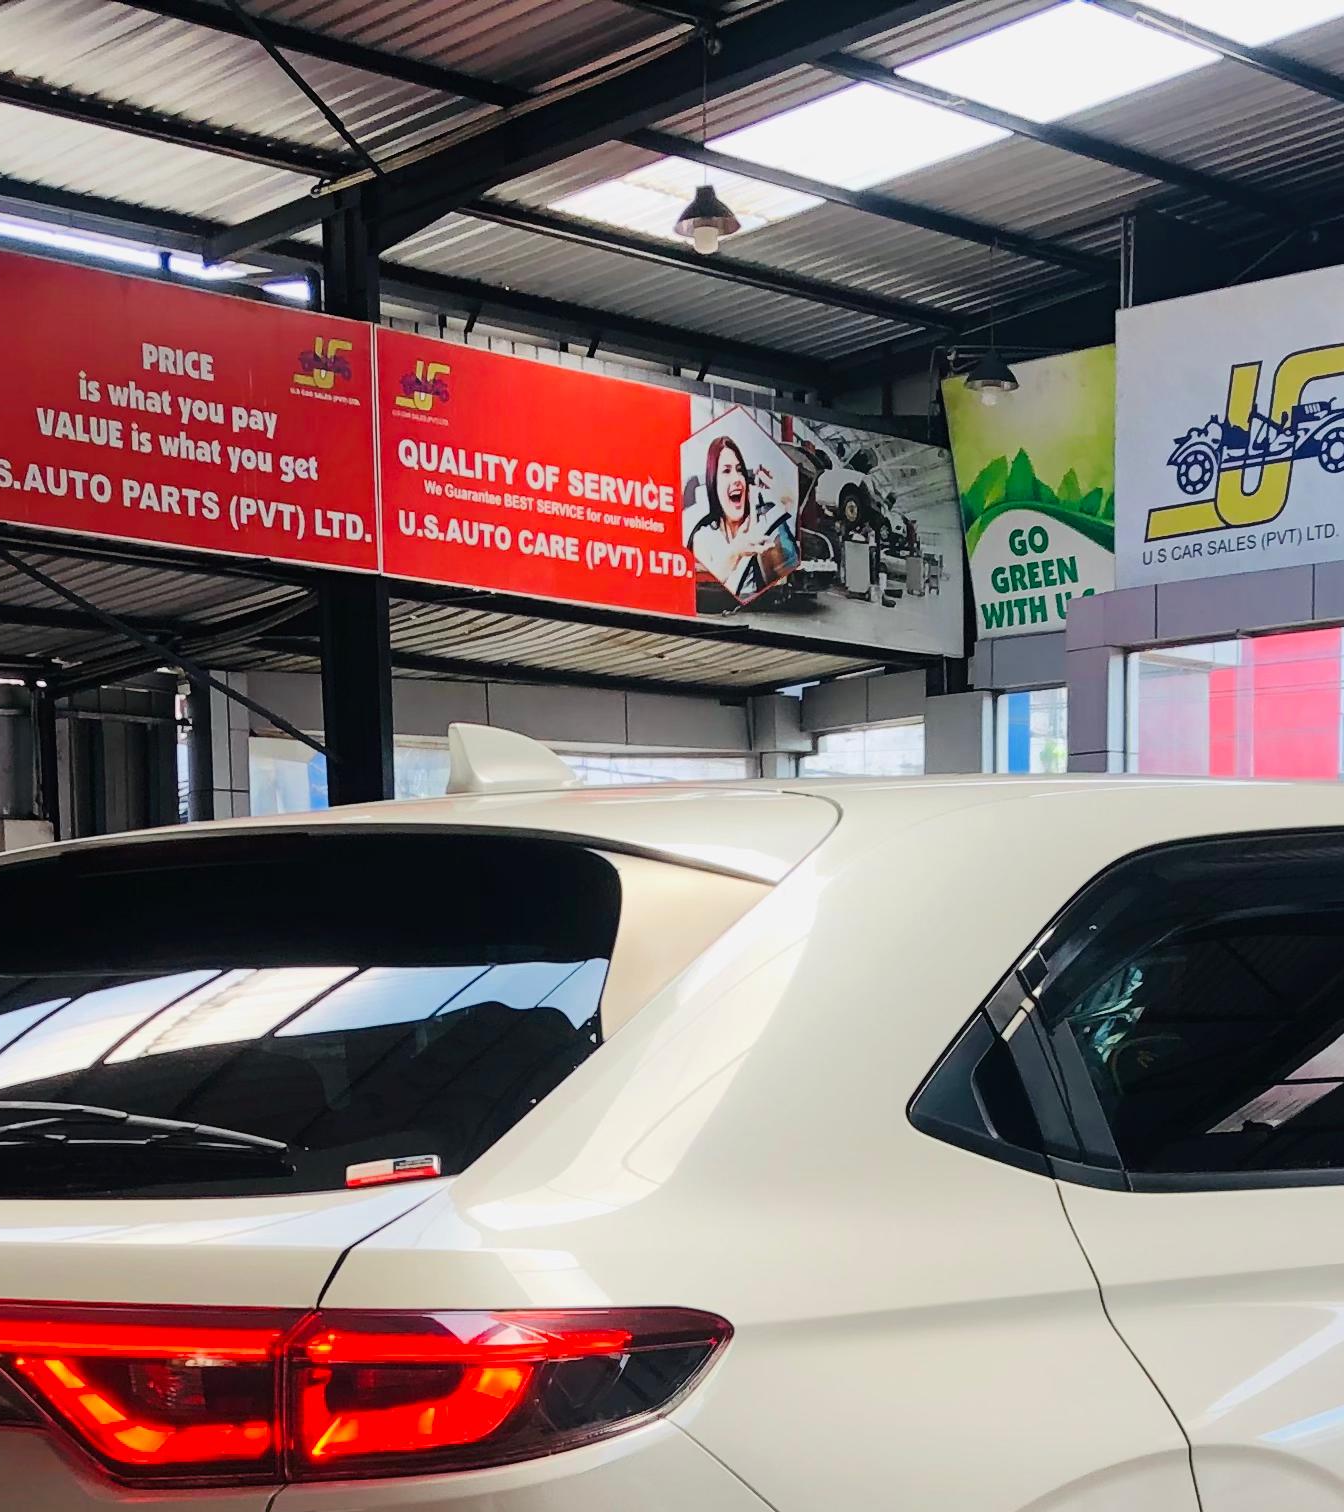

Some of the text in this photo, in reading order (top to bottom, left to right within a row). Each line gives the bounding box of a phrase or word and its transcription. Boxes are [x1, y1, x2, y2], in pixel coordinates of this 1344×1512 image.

[142, 343, 215, 381] PRICE
[79, 370, 277, 439] is what you pay
[36, 407, 318, 483] VALUE is what you get
[397, 439, 675, 513] QUALITY OF SERVICE
[122, 479, 220, 520] PARTS
[229, 496, 305, 540] (PVT)
[314, 509, 373, 543] LTD.
[424, 479, 665, 534] We Guarantee BEST SERVICE for our vehicles
[517, 530, 580, 562] CARE
[585, 539, 643, 577] (PVT)
[649, 550, 693, 579] LTD.
[1009, 526, 1049, 556] GO
[1171, 543, 1204, 562] CAR
[1207, 535, 1257, 559] SALES
[1260, 528, 1302, 551] (PVT)
[1305, 522, 1340, 544] LTD.
[991, 556, 1079, 594] GREEN
[981, 595, 1048, 630] WITH
